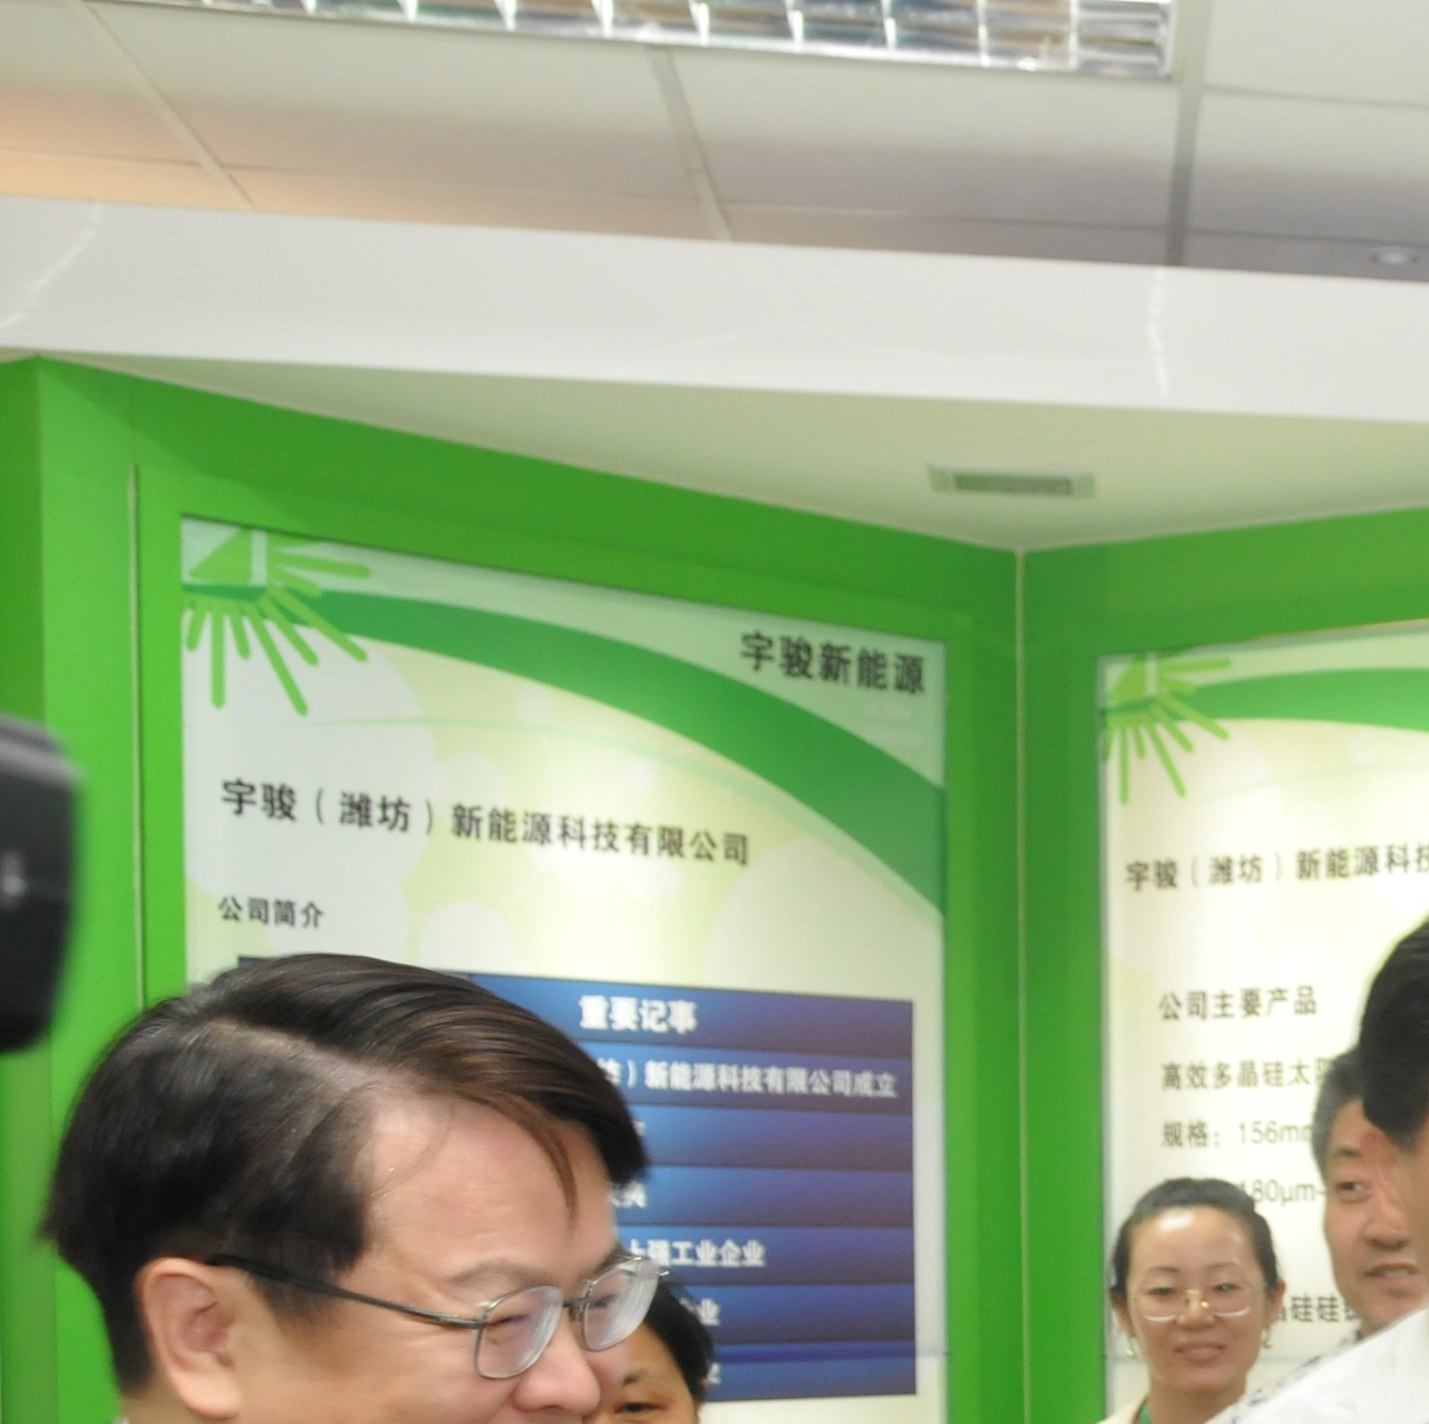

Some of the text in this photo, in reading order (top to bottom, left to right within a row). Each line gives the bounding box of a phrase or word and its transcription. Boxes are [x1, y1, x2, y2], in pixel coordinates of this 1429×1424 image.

[739, 629, 926, 695] 宇骏新能源
[220, 778, 751, 867] 宇骏（潍坊）新能源科技有限公司
[218, 894, 324, 930] 公司简介
[579, 994, 697, 1034] 重要记事
[1159, 985, 1317, 1022] 公司主要产品
